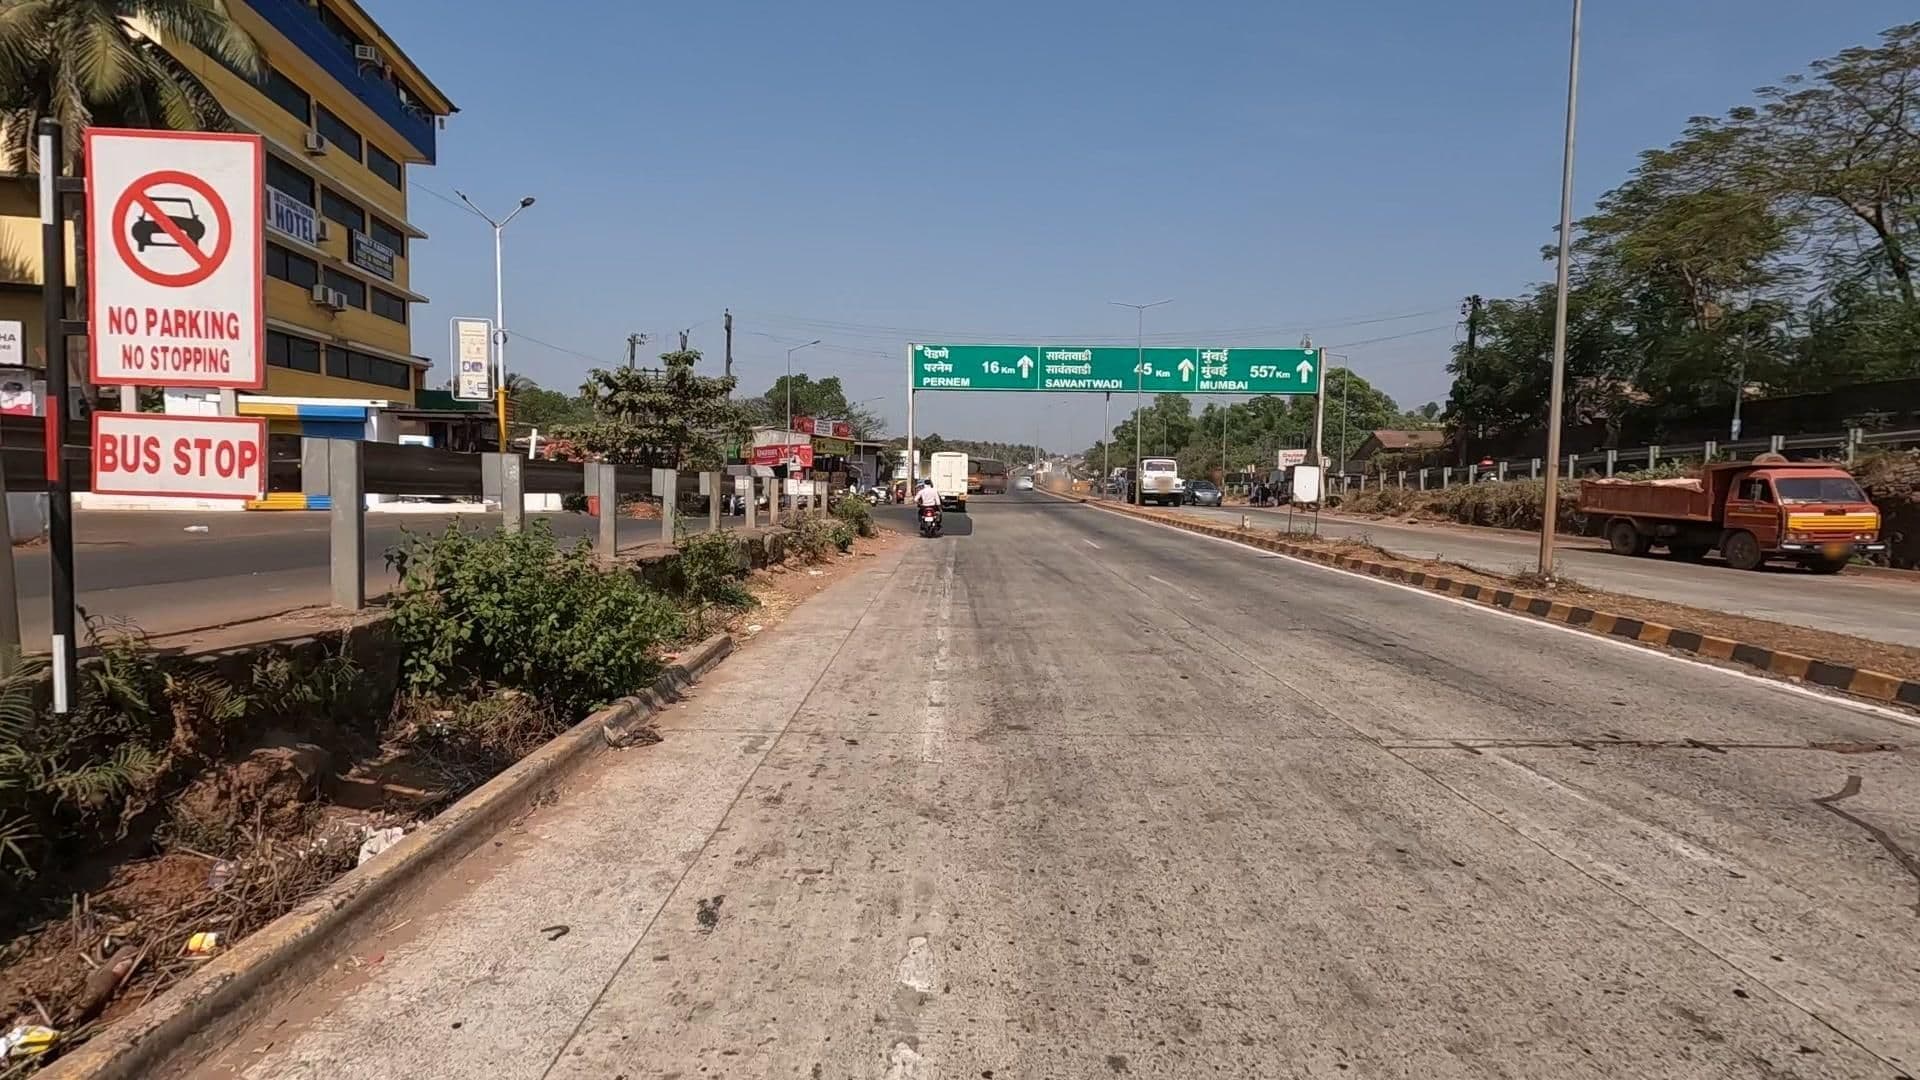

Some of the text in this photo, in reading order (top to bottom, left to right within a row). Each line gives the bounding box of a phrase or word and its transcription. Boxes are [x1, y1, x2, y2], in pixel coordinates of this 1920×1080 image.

[275, 203, 314, 243] HOTEL
[109, 306, 240, 340] NO PARKING
[122, 344, 230, 373] NO STOPPING
[1046, 349, 1092, 361] सावंतवाडी
[1201, 349, 1228, 364] मुंबई
[924, 362, 952, 373] परनेम
[982, 361, 999, 374] 16
[1046, 363, 1091, 375] सावंतवाडी
[1134, 363, 1153, 375] 45
[1201, 364, 1228, 378] मुंबई
[1250, 365, 1276, 378] 557
[923, 377, 970, 387] PERNEM
[1045, 379, 1123, 389] SAWANTWADI
[1200, 380, 1248, 390] MUMBAI
[99, 434, 257, 479] BUS STOP
